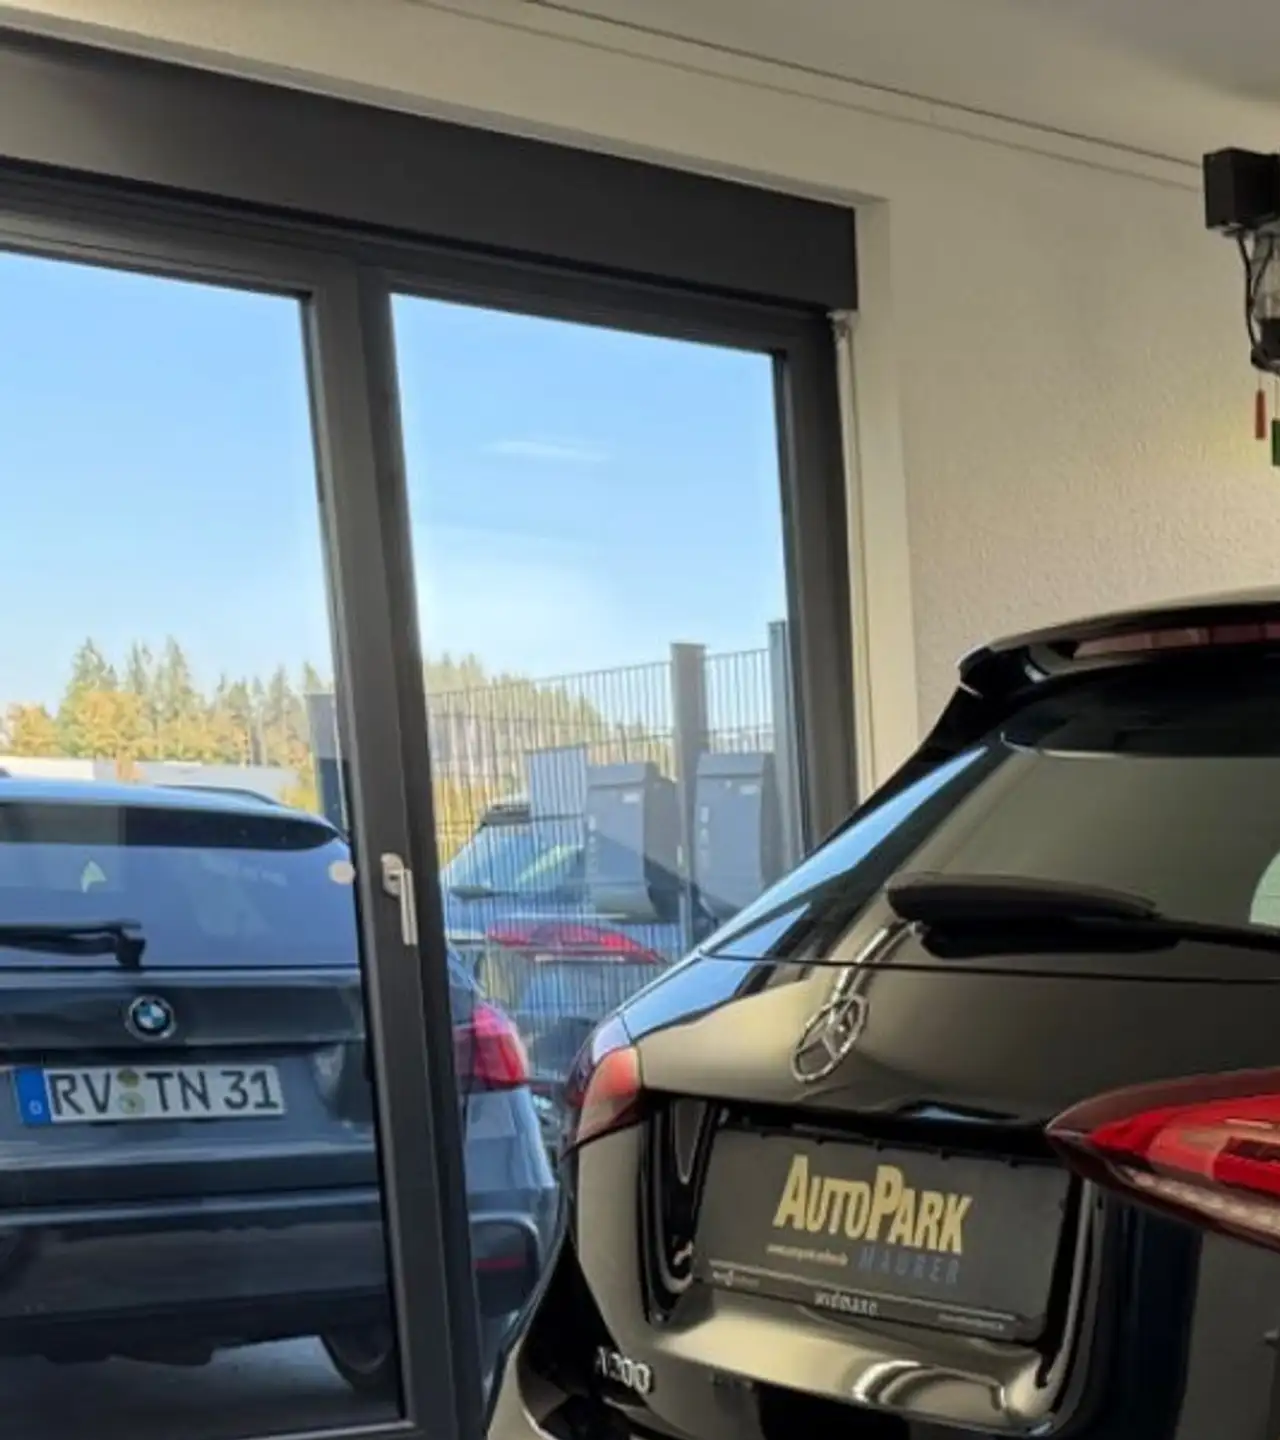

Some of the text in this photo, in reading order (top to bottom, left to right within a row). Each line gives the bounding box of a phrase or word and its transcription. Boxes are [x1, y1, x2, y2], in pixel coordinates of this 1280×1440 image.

[50, 1070, 279, 1115] RV TN 31
